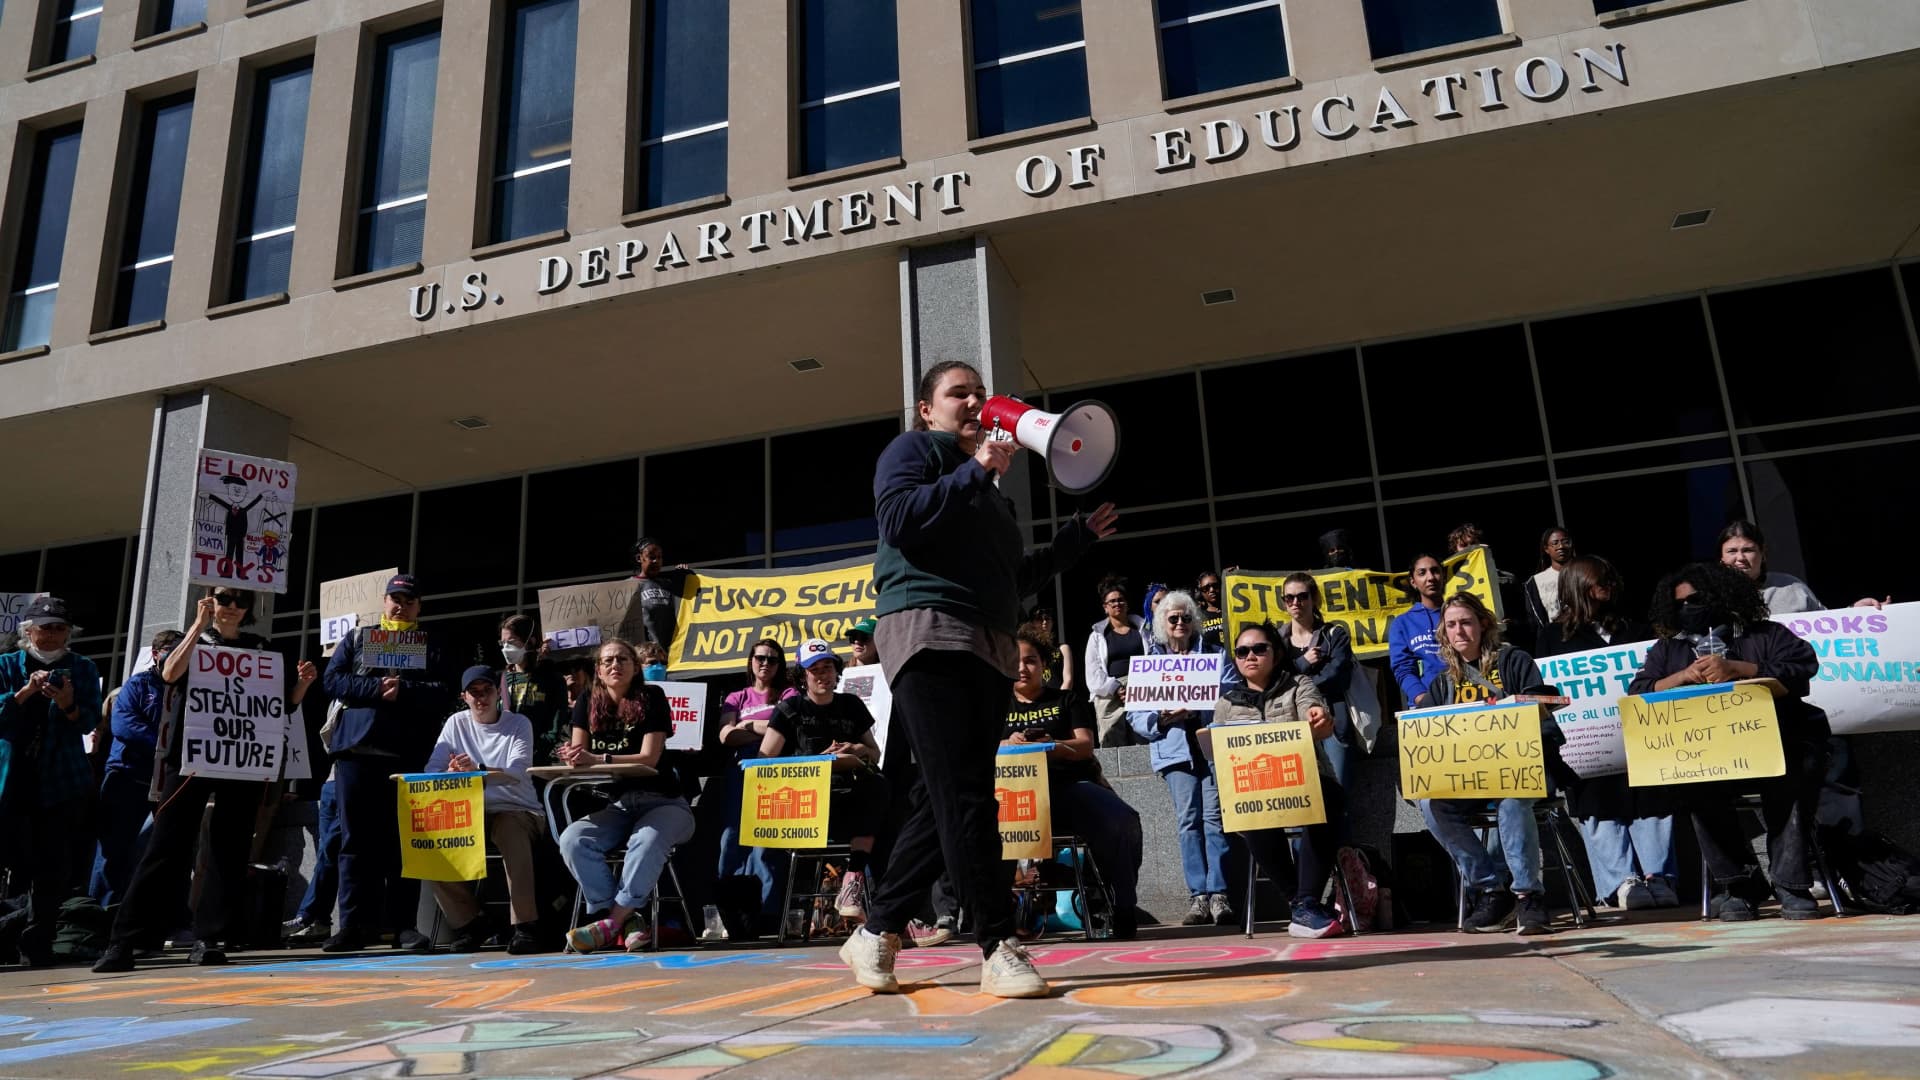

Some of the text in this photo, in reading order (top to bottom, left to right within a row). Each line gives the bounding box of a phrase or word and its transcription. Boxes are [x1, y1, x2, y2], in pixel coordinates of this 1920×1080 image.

[409, 41, 1629, 321] U.S. DEPARTMENT OF EDUCATION
[204, 456, 290, 489] ELON'S
[197, 520, 224, 535] YOUR
[199, 535, 224, 552] DATA
[194, 551, 275, 584] TOYS
[323, 579, 368, 612] THANK
[692, 585, 787, 614] FUND
[1230, 574, 1412, 614] STUENTS
[547, 590, 601, 622] THANK
[607, 588, 636, 611] YOU
[328, 617, 351, 640] ED
[1788, 614, 1889, 637] OOKS
[554, 628, 591, 649] ED
[692, 626, 753, 657] NOT
[1810, 637, 1880, 658] VER
[198, 649, 274, 679] DOGE
[377, 653, 417, 669] FUTURE
[1132, 658, 1218, 673] EDUCATION
[225, 676, 245, 695] IS
[1161, 672, 1184, 682] is a
[189, 688, 282, 718] STEALING
[1127, 685, 1219, 703] HUMAN RIGHT
[1005, 705, 1061, 722] UNRISE
[1474, 712, 1519, 733] CAN
[1633, 698, 1693, 727] WWE
[213, 717, 256, 741] OUR
[1226, 728, 1302, 749] KIDS DESERVE
[1684, 725, 1717, 743] NOT
[1727, 719, 1768, 735] TAKE
[187, 739, 275, 768] FUTURE
[1403, 744, 1445, 769] YOU
[1453, 743, 1509, 763] LOOK
[1516, 739, 1541, 759] US
[1675, 748, 1709, 762] Our
[756, 765, 821, 779] KIDS DESERVE
[1410, 764, 1544, 794] IN THE EYES?
[1659, 762, 1729, 782] Education
[409, 777, 473, 794] KIDS DESERVE
[1234, 794, 1312, 815] GOOD SCHOOLS
[410, 835, 476, 850] GOOD SCHOOLS
[753, 826, 820, 839] GOOD SCHOOLS
